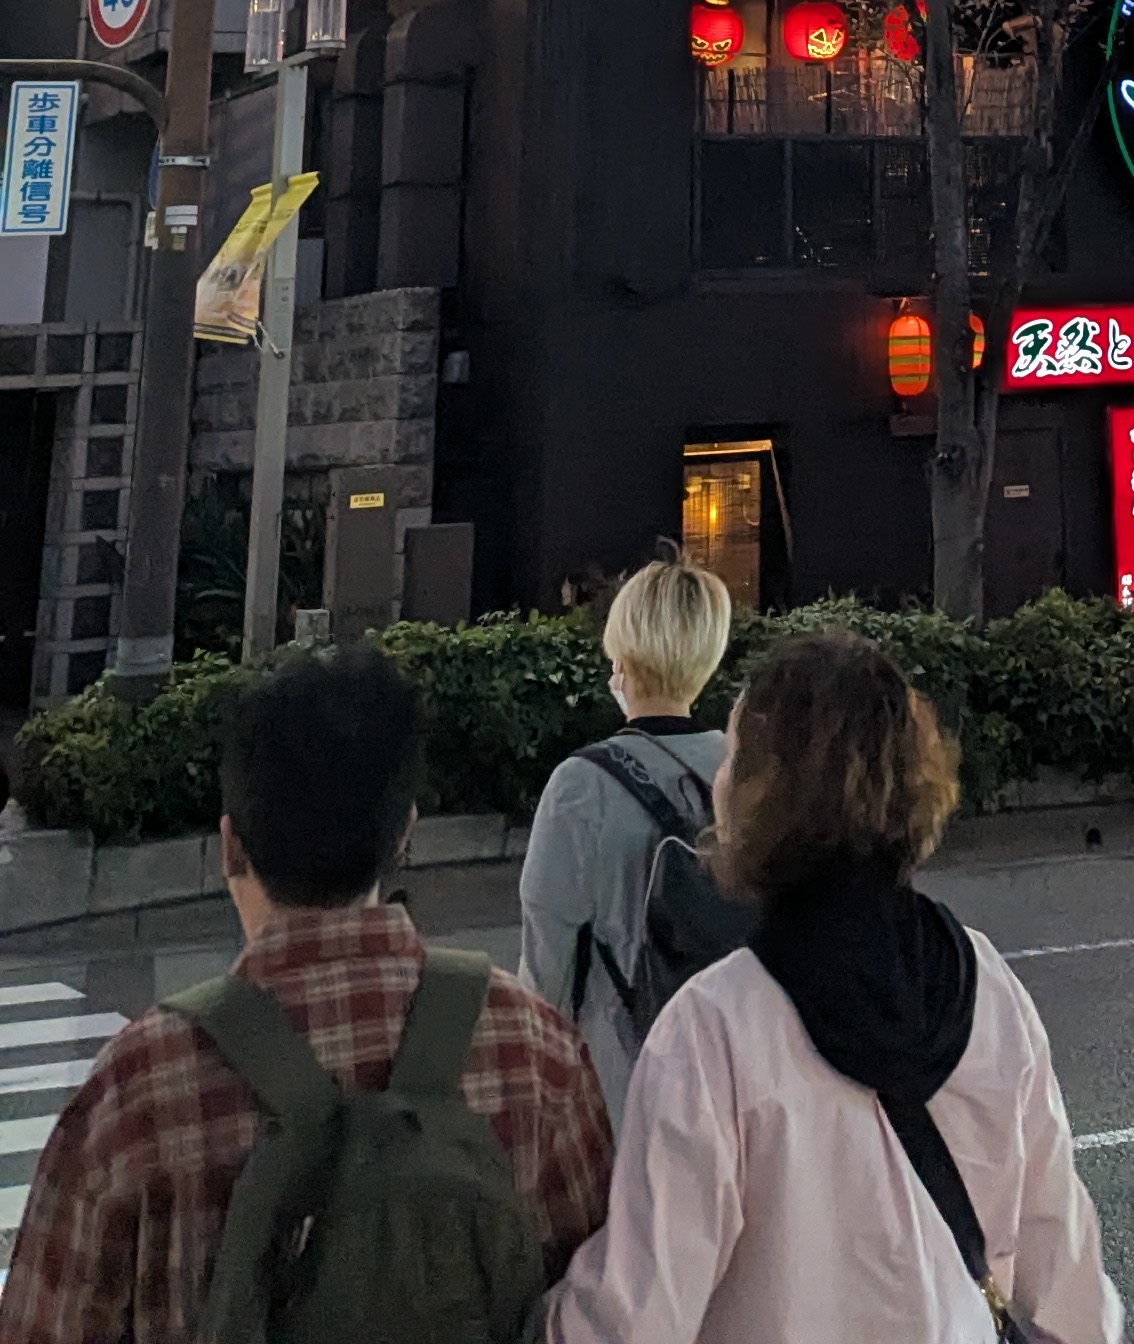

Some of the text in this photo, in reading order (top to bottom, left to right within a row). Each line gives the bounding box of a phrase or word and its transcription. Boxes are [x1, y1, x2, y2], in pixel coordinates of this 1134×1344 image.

[18, 92, 61, 224] 歩車分離信号
